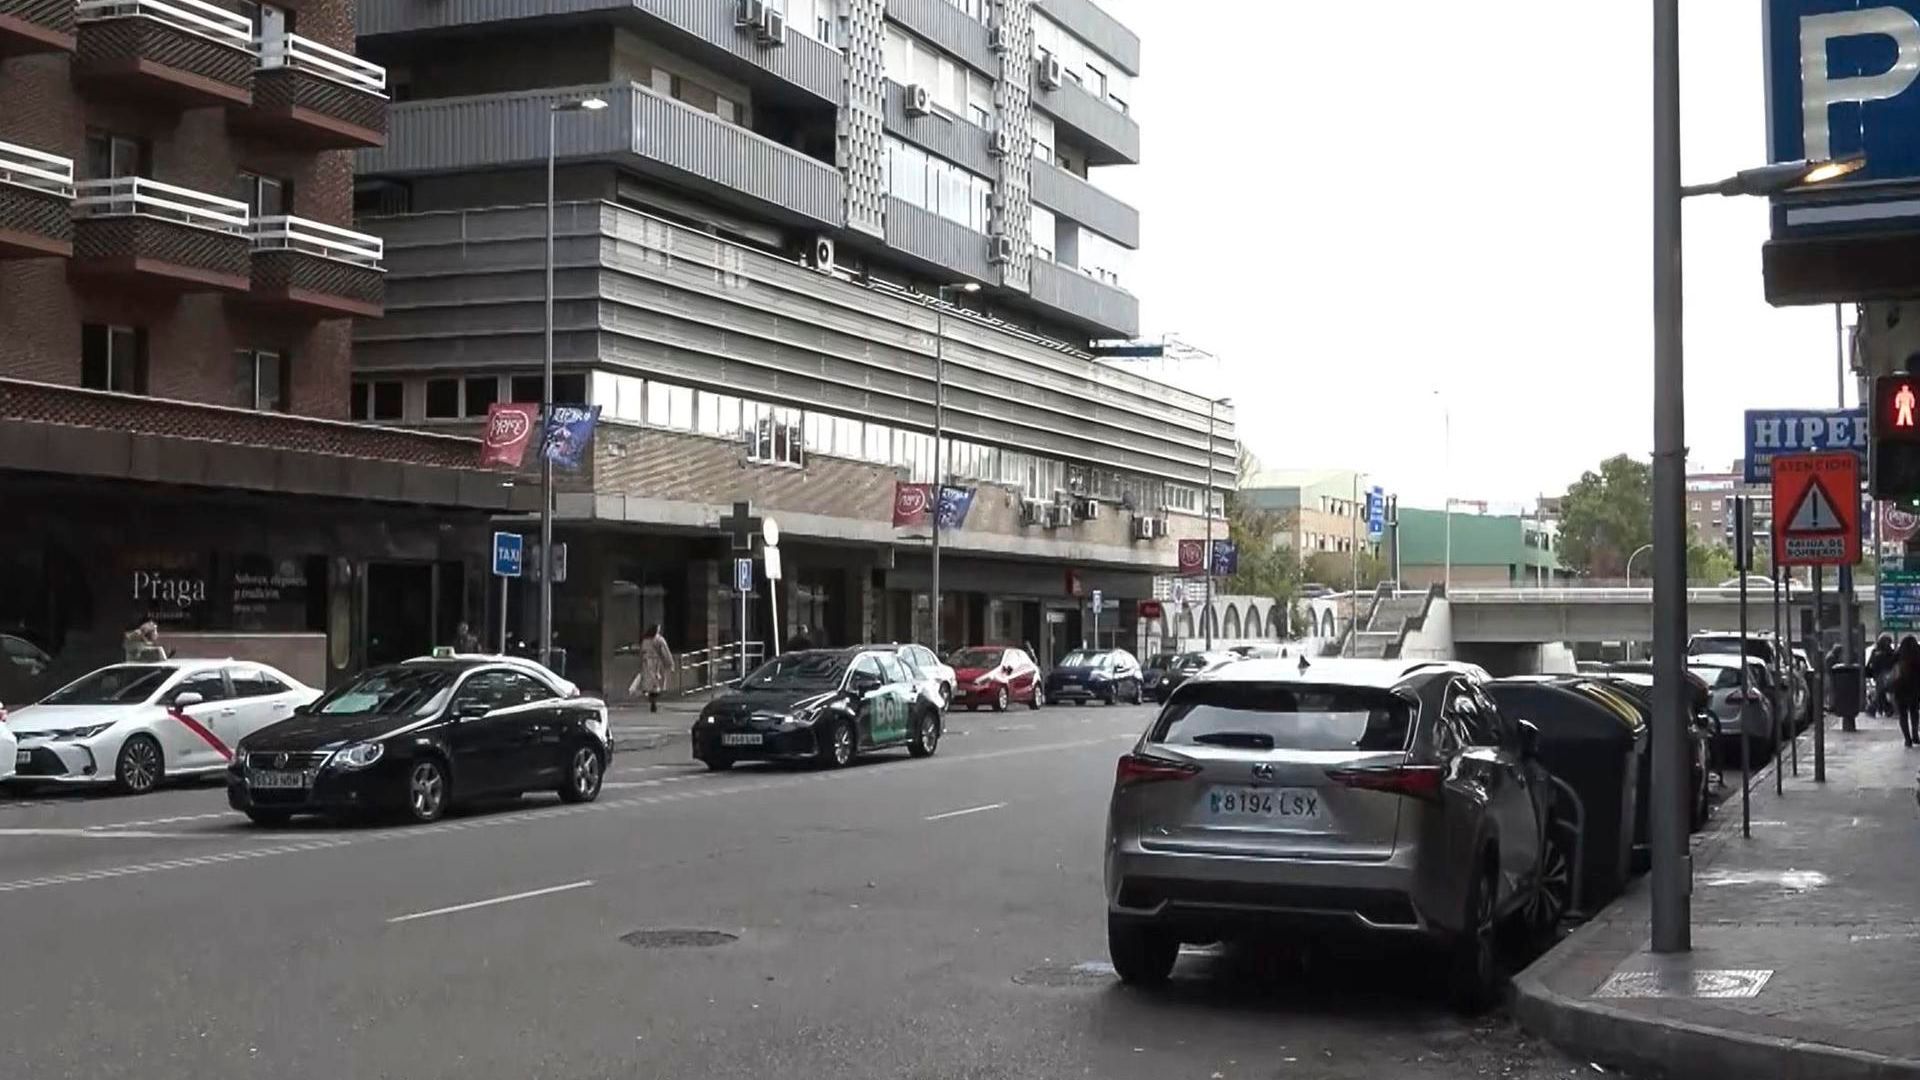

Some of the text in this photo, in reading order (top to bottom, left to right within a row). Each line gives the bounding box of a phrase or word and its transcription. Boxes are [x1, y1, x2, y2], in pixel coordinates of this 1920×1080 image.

[1800, 6, 1920, 163] P
[499, 547, 520, 562] TAXI
[1224, 793, 1317, 816] 8194 LSX
